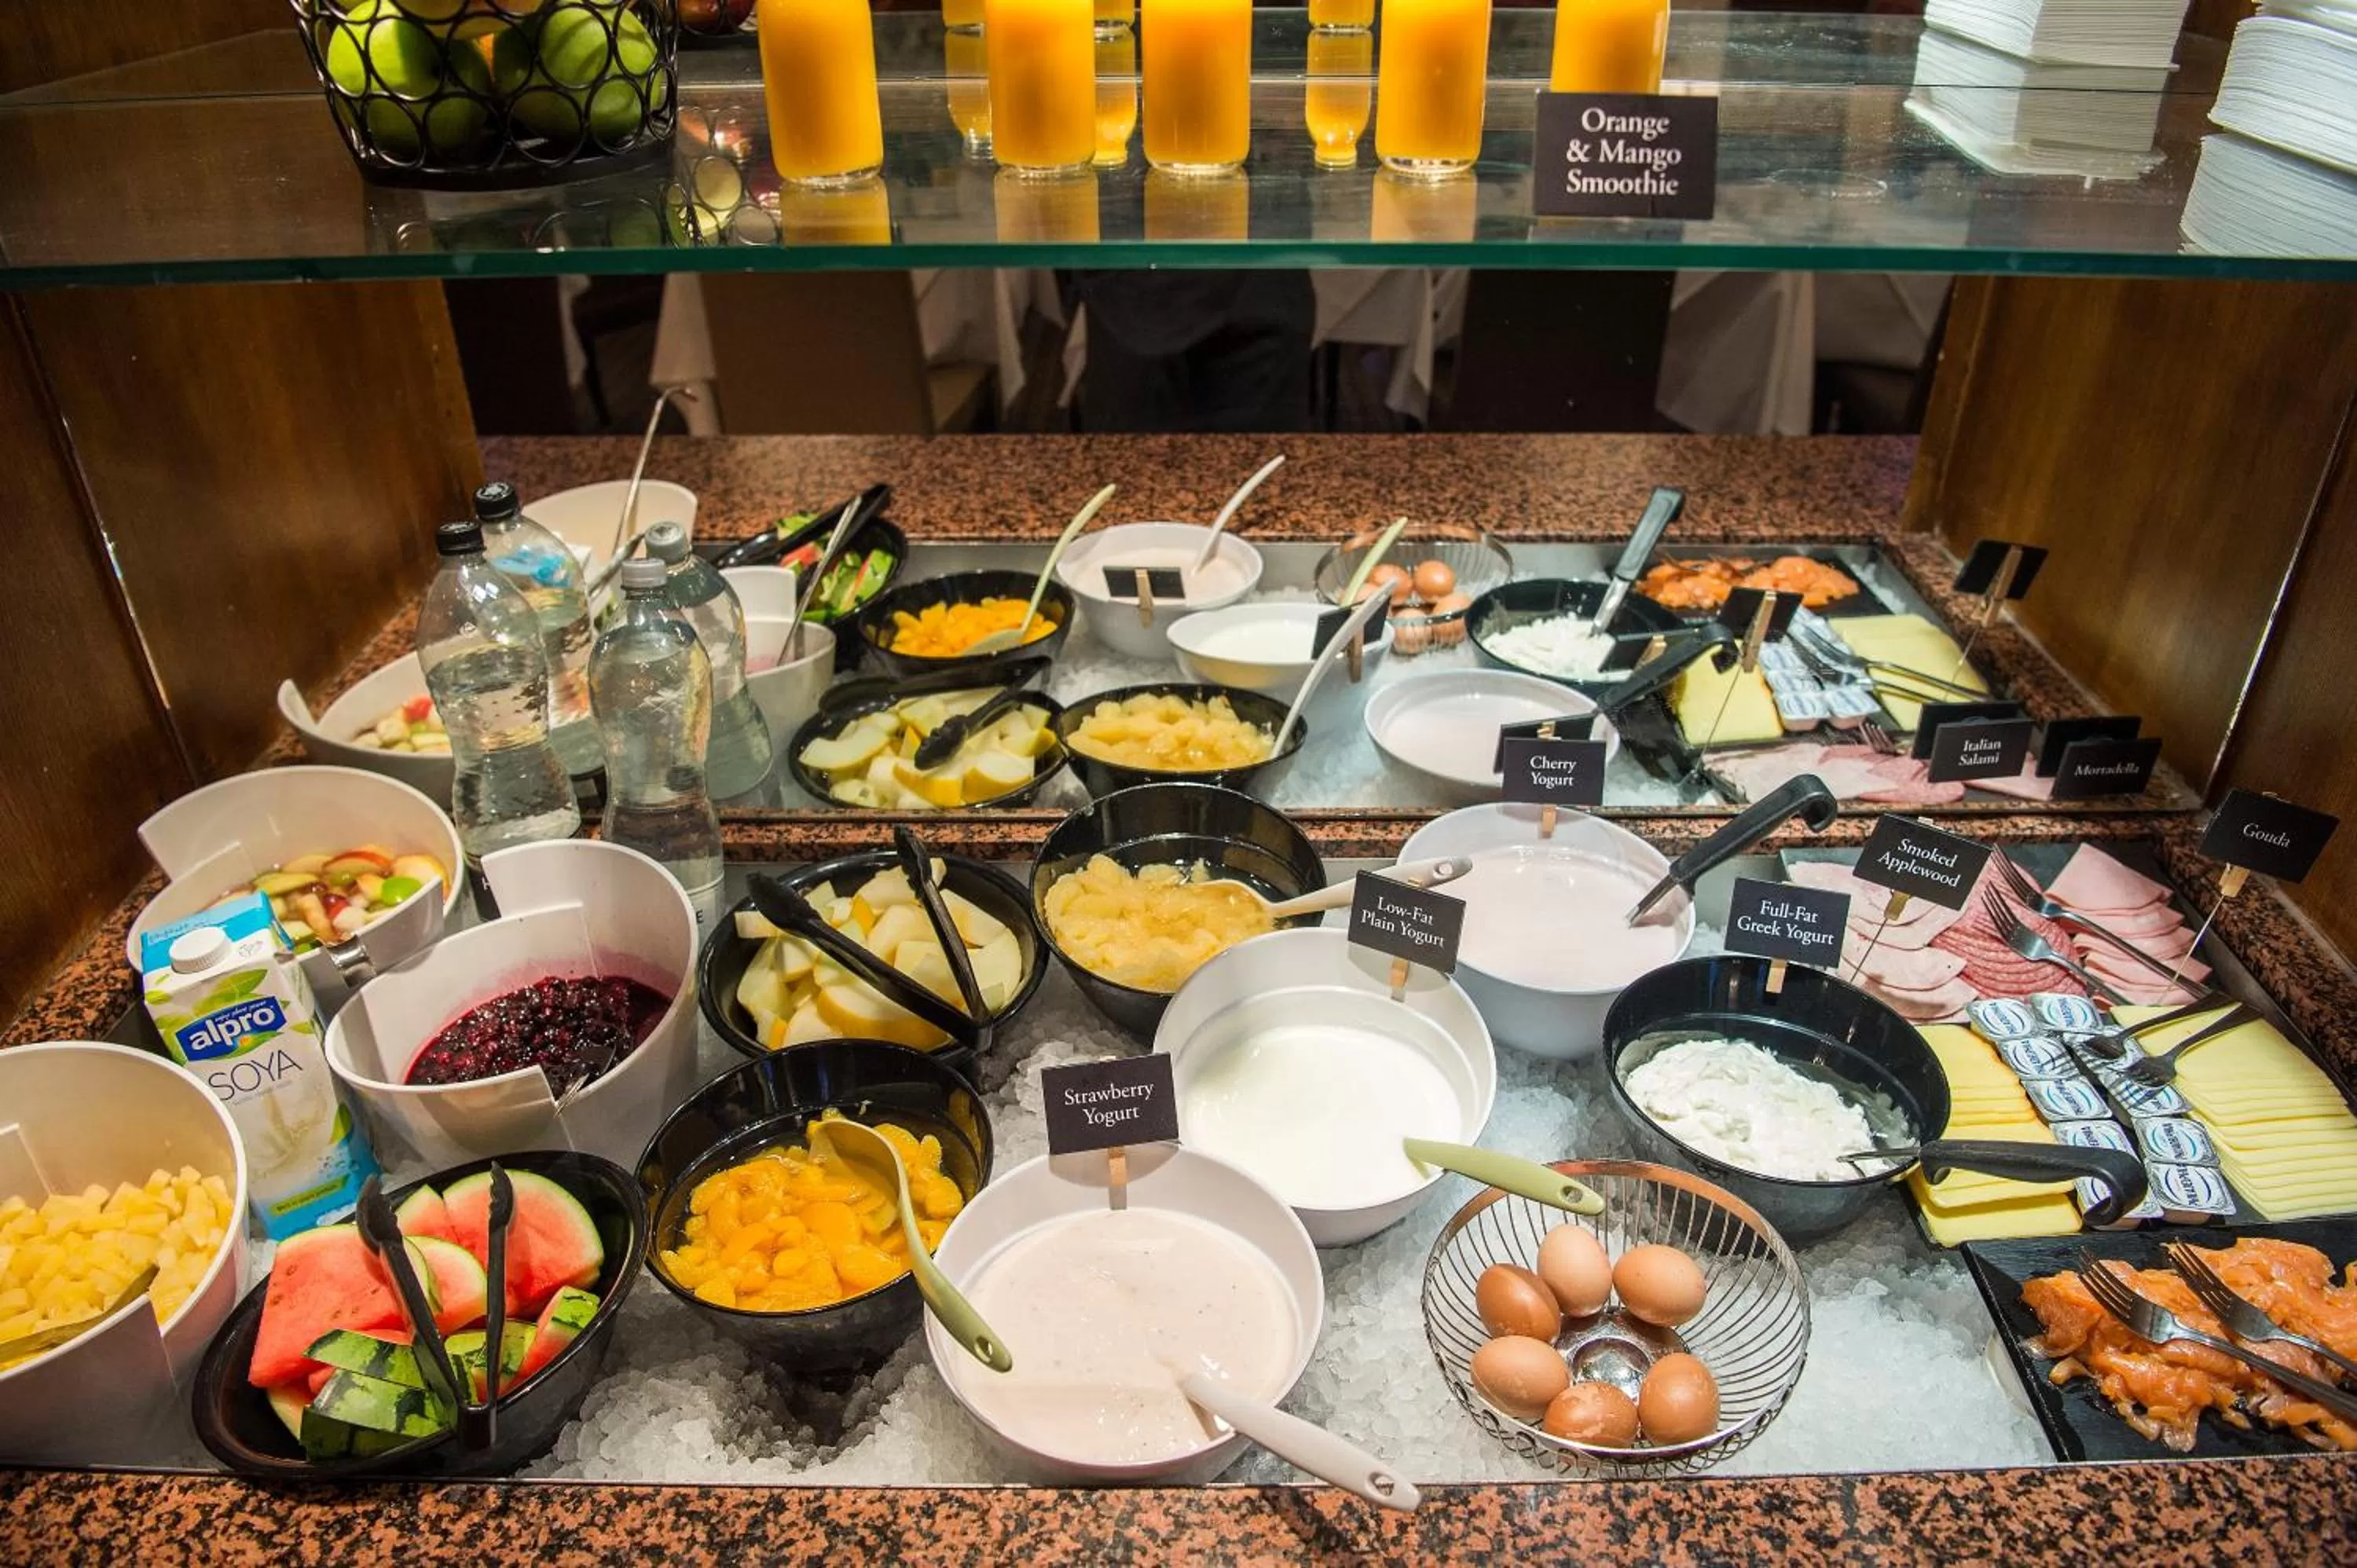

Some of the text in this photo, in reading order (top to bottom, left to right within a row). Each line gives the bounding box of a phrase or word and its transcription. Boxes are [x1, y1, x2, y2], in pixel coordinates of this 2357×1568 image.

[1581, 107, 1670, 141] Orange
[1566, 138, 1682, 172] & Mango
[1566, 168, 1680, 196] Smoothie
[1958, 752, 2000, 766] Salami
[1963, 738, 2001, 752] Italian
[1530, 755, 1577, 774] Cherry
[1531, 772, 1574, 789] Yogurt
[2243, 822, 2291, 848] Gouda
[1897, 838, 1958, 868] Smoked
[1877, 851, 1962, 888] Applewood
[1377, 896, 1434, 926] Low-Fat
[1760, 899, 1819, 923] Full-Fat
[1361, 909, 1446, 947] Plain Yogurt
[1737, 915, 1835, 945] Greek Yogurt
[189, 1008, 275, 1051] alpro
[208, 1050, 303, 1101] SOYA
[1064, 1083, 1154, 1105] Strawberry
[1082, 1107, 1140, 1127] Yogurt
